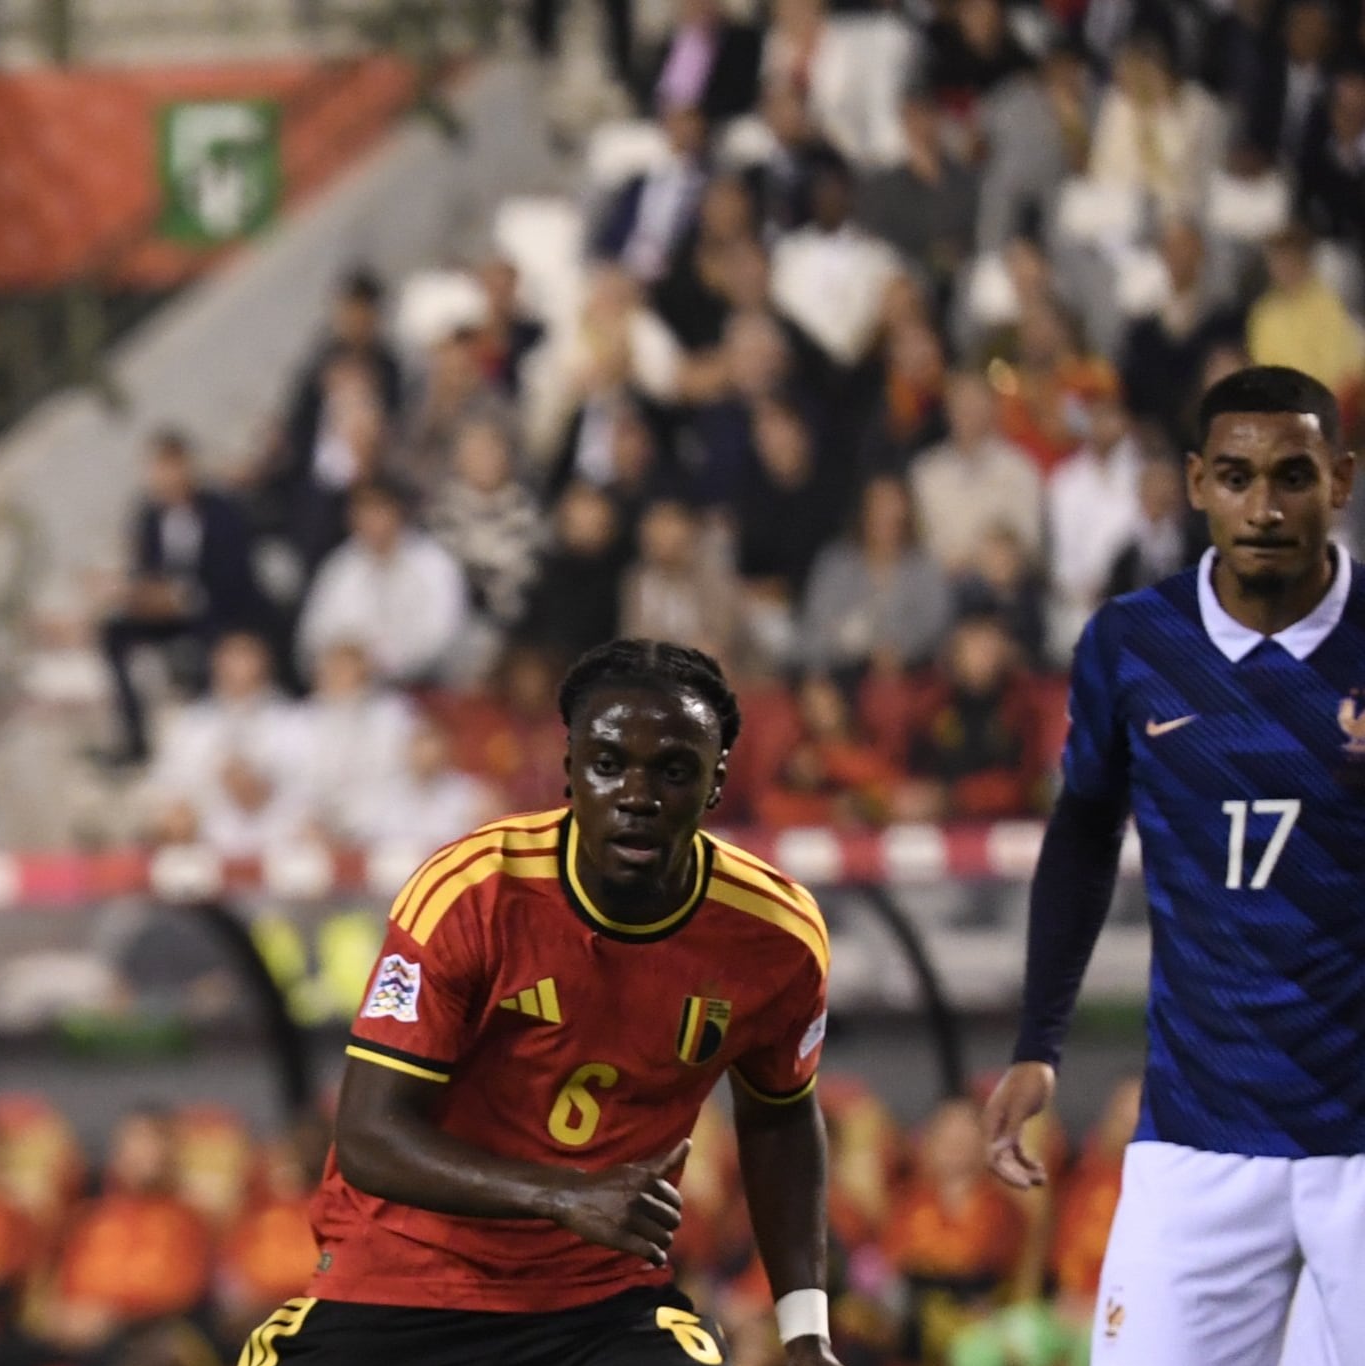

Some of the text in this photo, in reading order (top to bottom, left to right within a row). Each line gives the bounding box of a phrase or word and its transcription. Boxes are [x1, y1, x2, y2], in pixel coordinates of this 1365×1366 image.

[1221, 798, 1302, 890] 17
[548, 1062, 619, 1146] 6
[655, 1306, 724, 1366] 6
